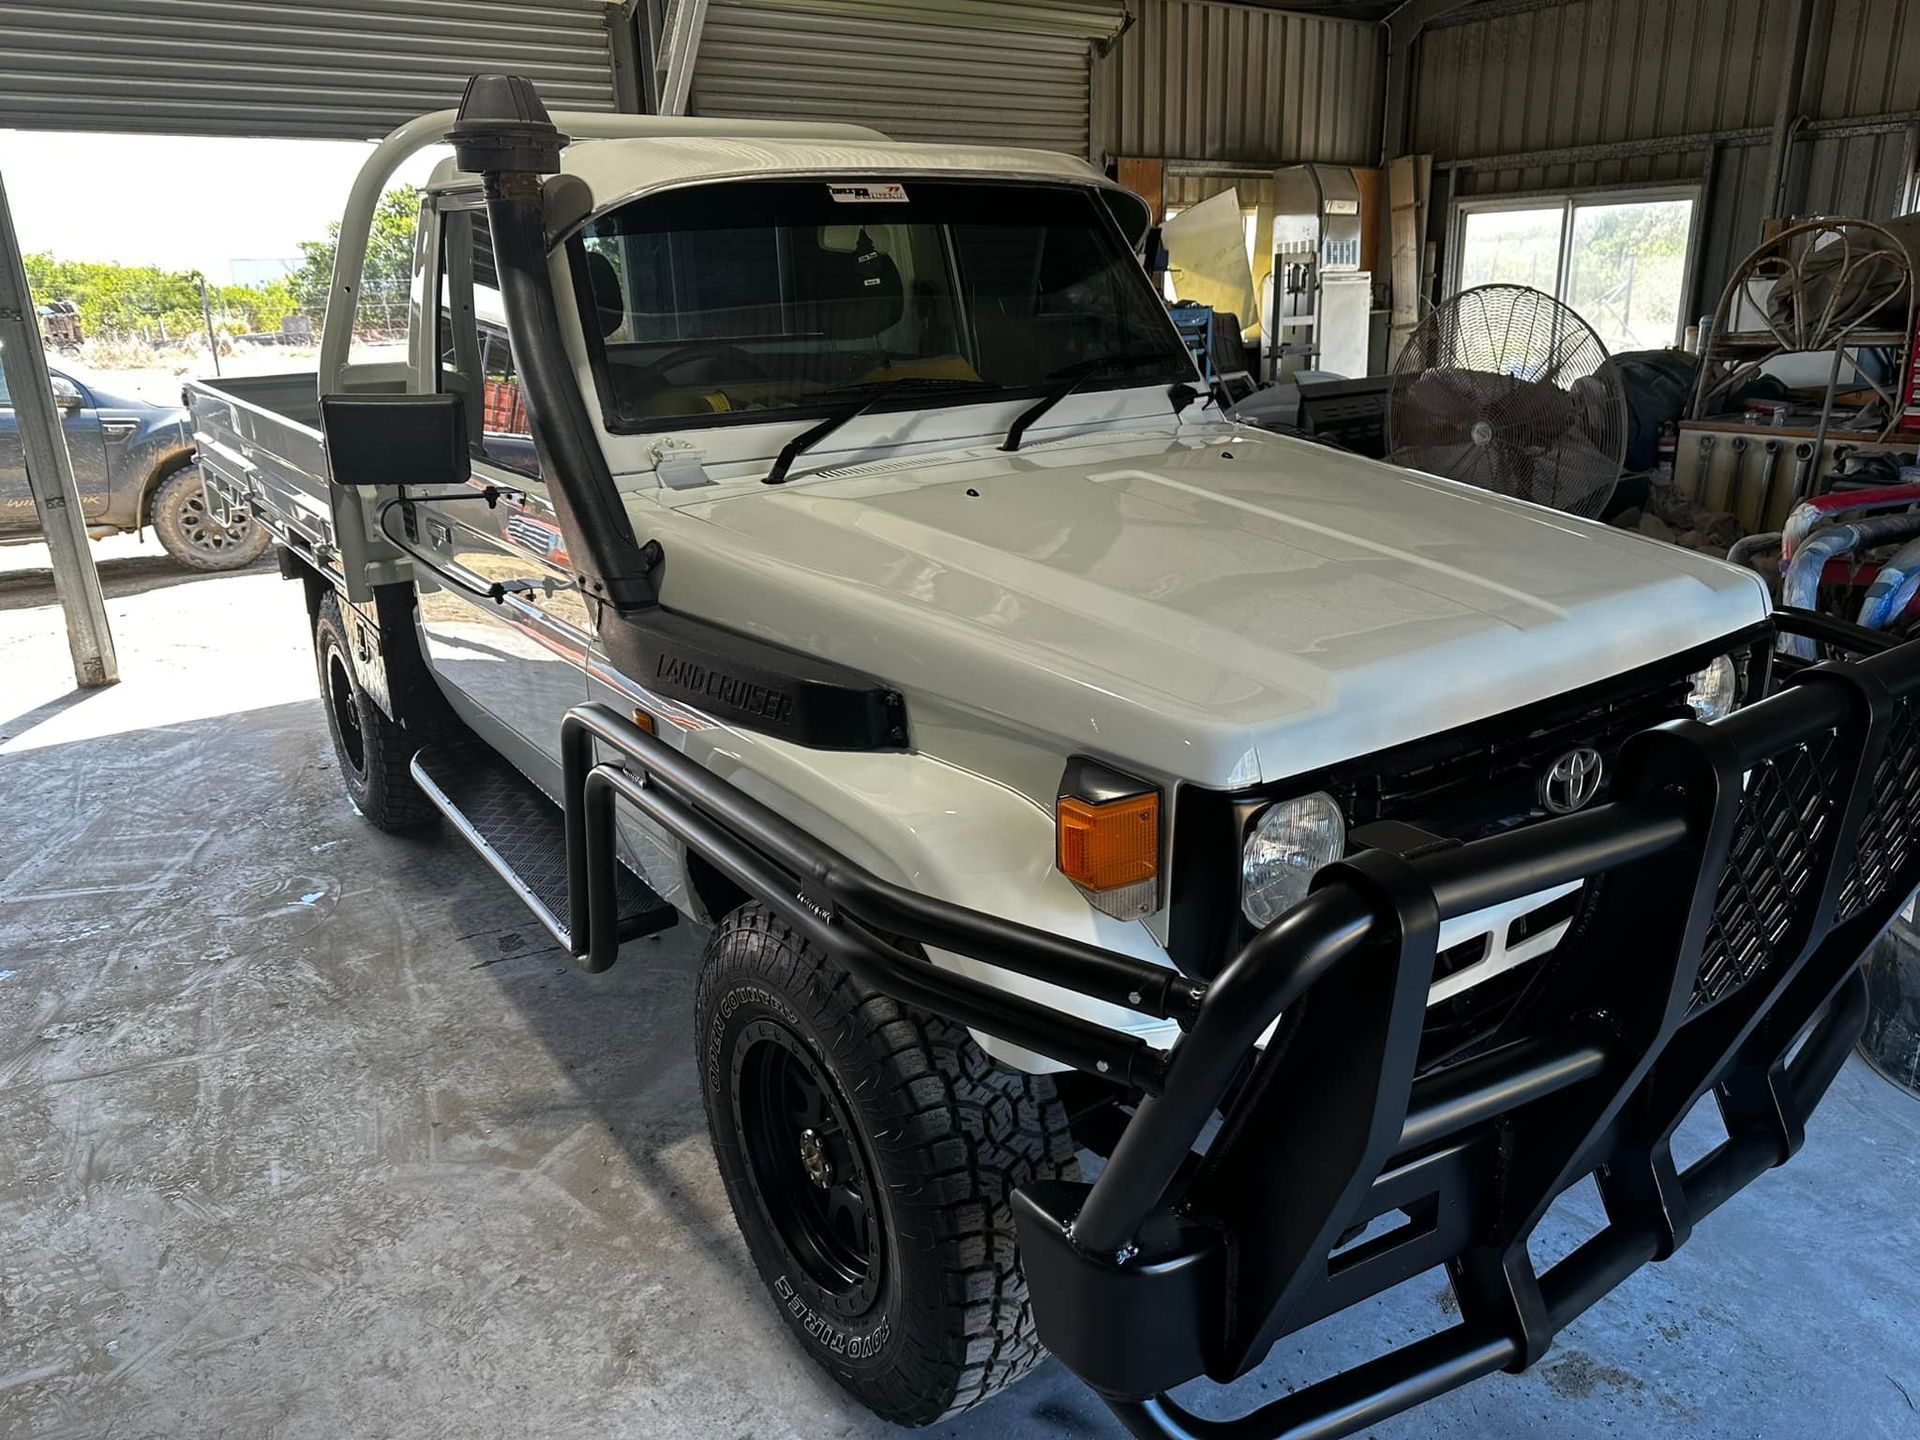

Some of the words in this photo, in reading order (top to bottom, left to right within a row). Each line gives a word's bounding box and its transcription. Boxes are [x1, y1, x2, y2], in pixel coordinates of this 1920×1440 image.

[656, 653, 794, 725] LANDCRUISER
[709, 1013, 727, 1093] OPEN
[720, 986, 798, 1024] COUNTRY
[774, 1275, 846, 1354] TIRES
[847, 1312, 890, 1358] TOYO
